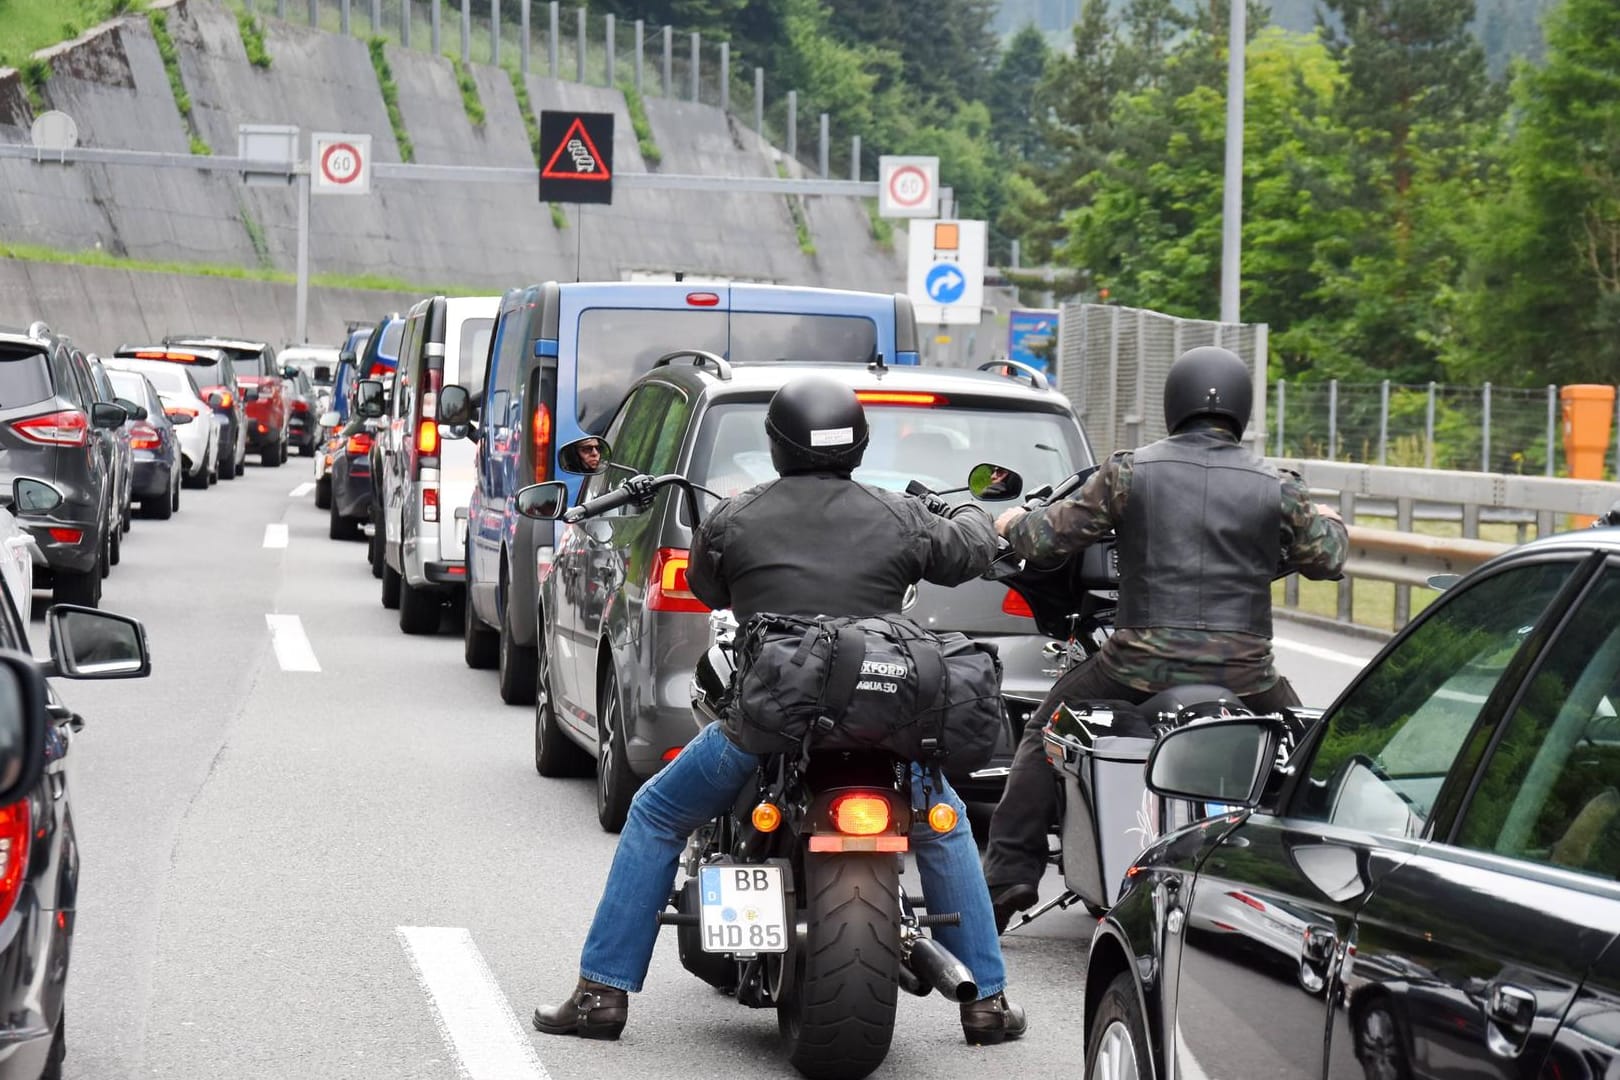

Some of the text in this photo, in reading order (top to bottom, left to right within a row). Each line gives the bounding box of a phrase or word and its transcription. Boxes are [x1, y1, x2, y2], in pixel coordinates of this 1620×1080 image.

[333, 156, 350, 171] 60
[861, 662, 905, 676] XFORD
[735, 869, 769, 891] BB
[707, 890, 717, 902] D
[707, 924, 781, 947] HD 85
